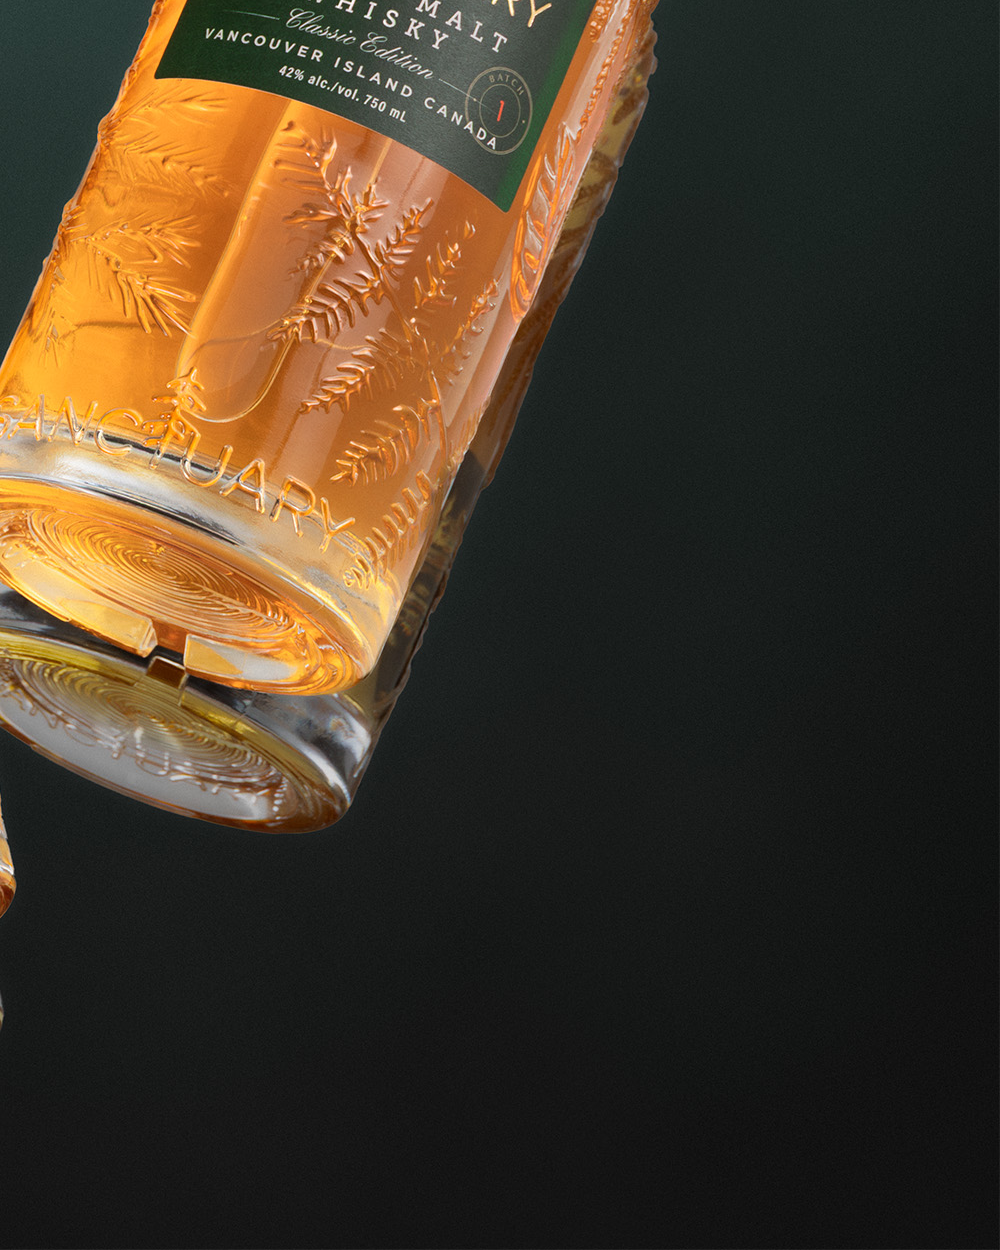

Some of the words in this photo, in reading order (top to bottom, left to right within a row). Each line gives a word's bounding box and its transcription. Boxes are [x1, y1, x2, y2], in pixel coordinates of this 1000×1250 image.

[285, 7, 357, 46] Classic
[359, 31, 435, 80] Edition
[204, 27, 325, 63] VANCOUVER
[333, 56, 414, 99] ISLAND
[423, 96, 497, 150] CANADA
[278, 64, 305, 82] 42%
[307, 75, 360, 102] alc./vol.
[362, 94, 387, 113] 750
[389, 107, 407, 124] mL
[488, 73, 525, 97] BATCH
[496, 100, 505, 122] 1
